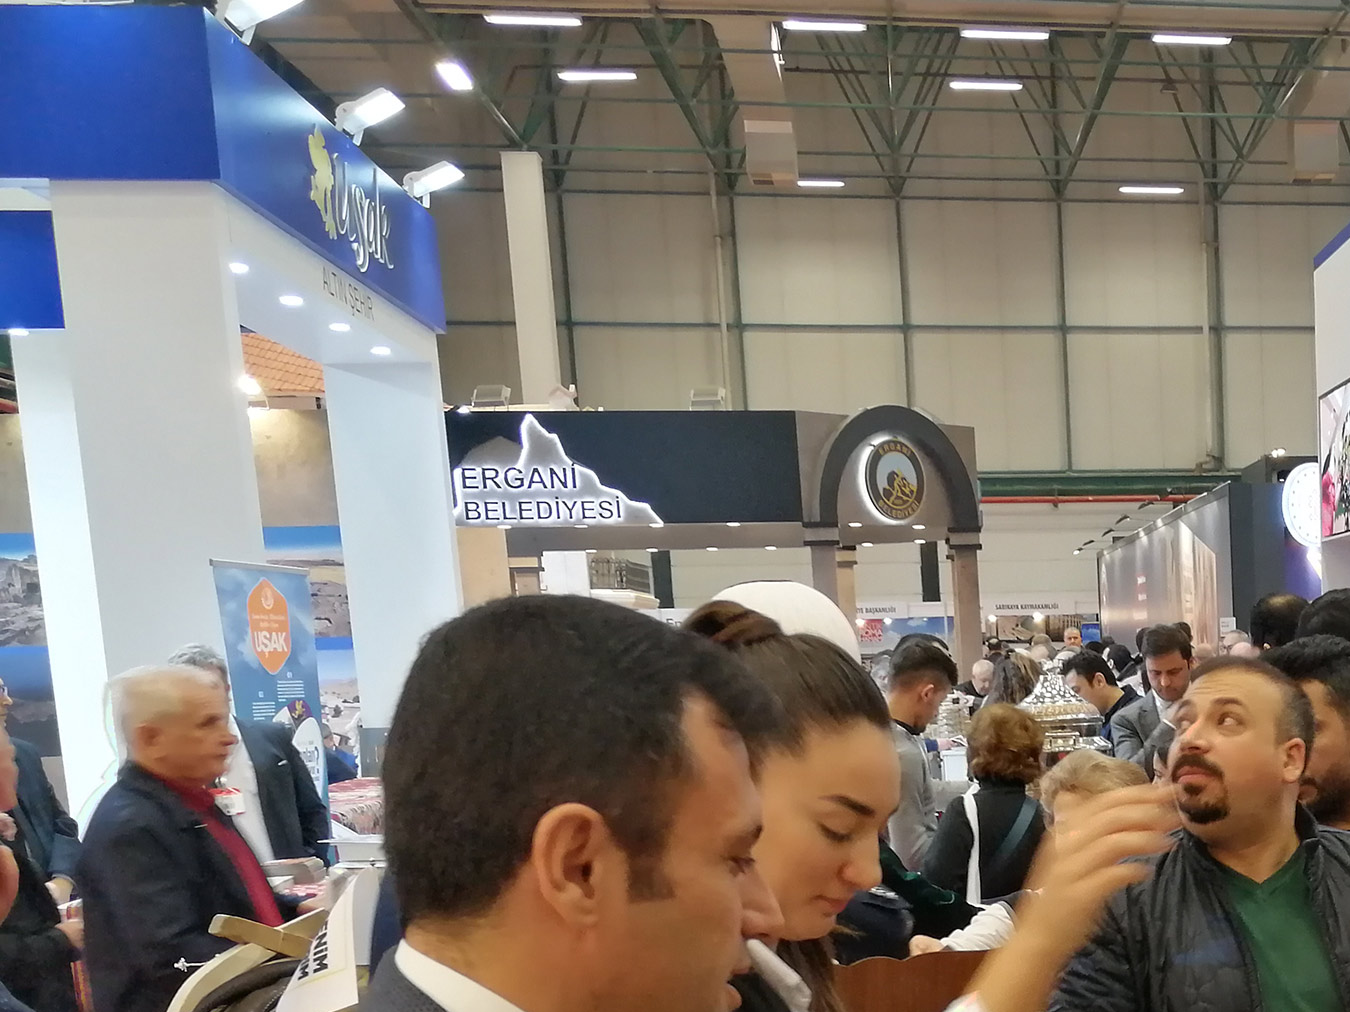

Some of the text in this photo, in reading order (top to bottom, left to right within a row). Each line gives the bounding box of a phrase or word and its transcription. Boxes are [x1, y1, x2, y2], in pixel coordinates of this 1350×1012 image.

[461, 462, 577, 490] ERGANİ
[464, 496, 622, 521] BELEDİYESİ
[254, 630, 288, 658] UŞAK
